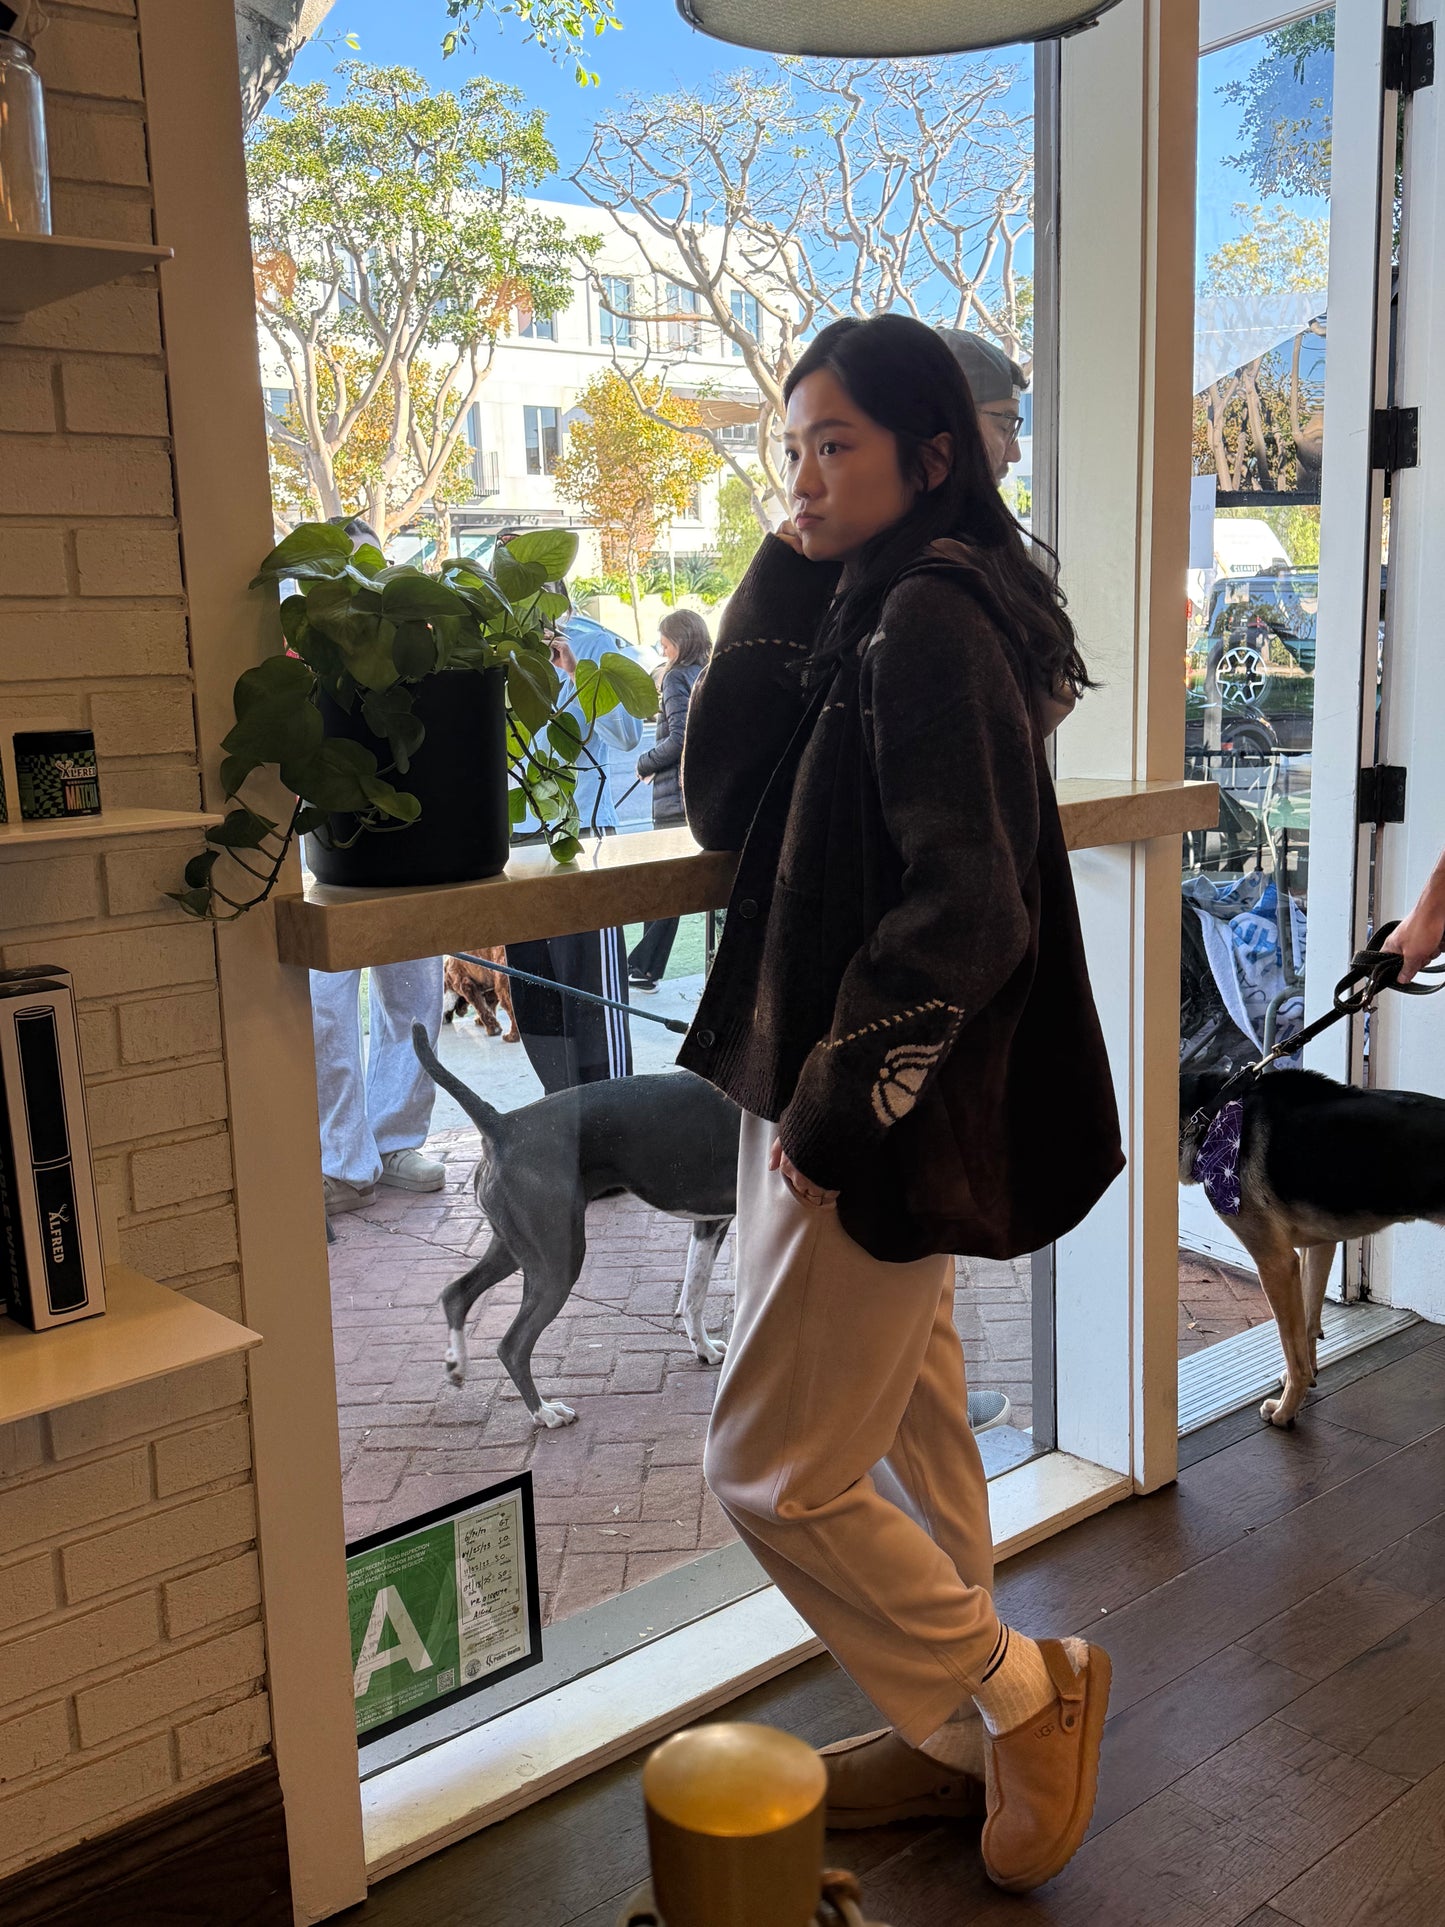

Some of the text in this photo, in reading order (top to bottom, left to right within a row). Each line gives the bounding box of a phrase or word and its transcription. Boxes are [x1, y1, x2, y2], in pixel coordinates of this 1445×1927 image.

[48, 1207, 67, 1264] ALFRED
[353, 1585, 434, 1699] A
[1033, 1722, 1056, 1740] UGG
